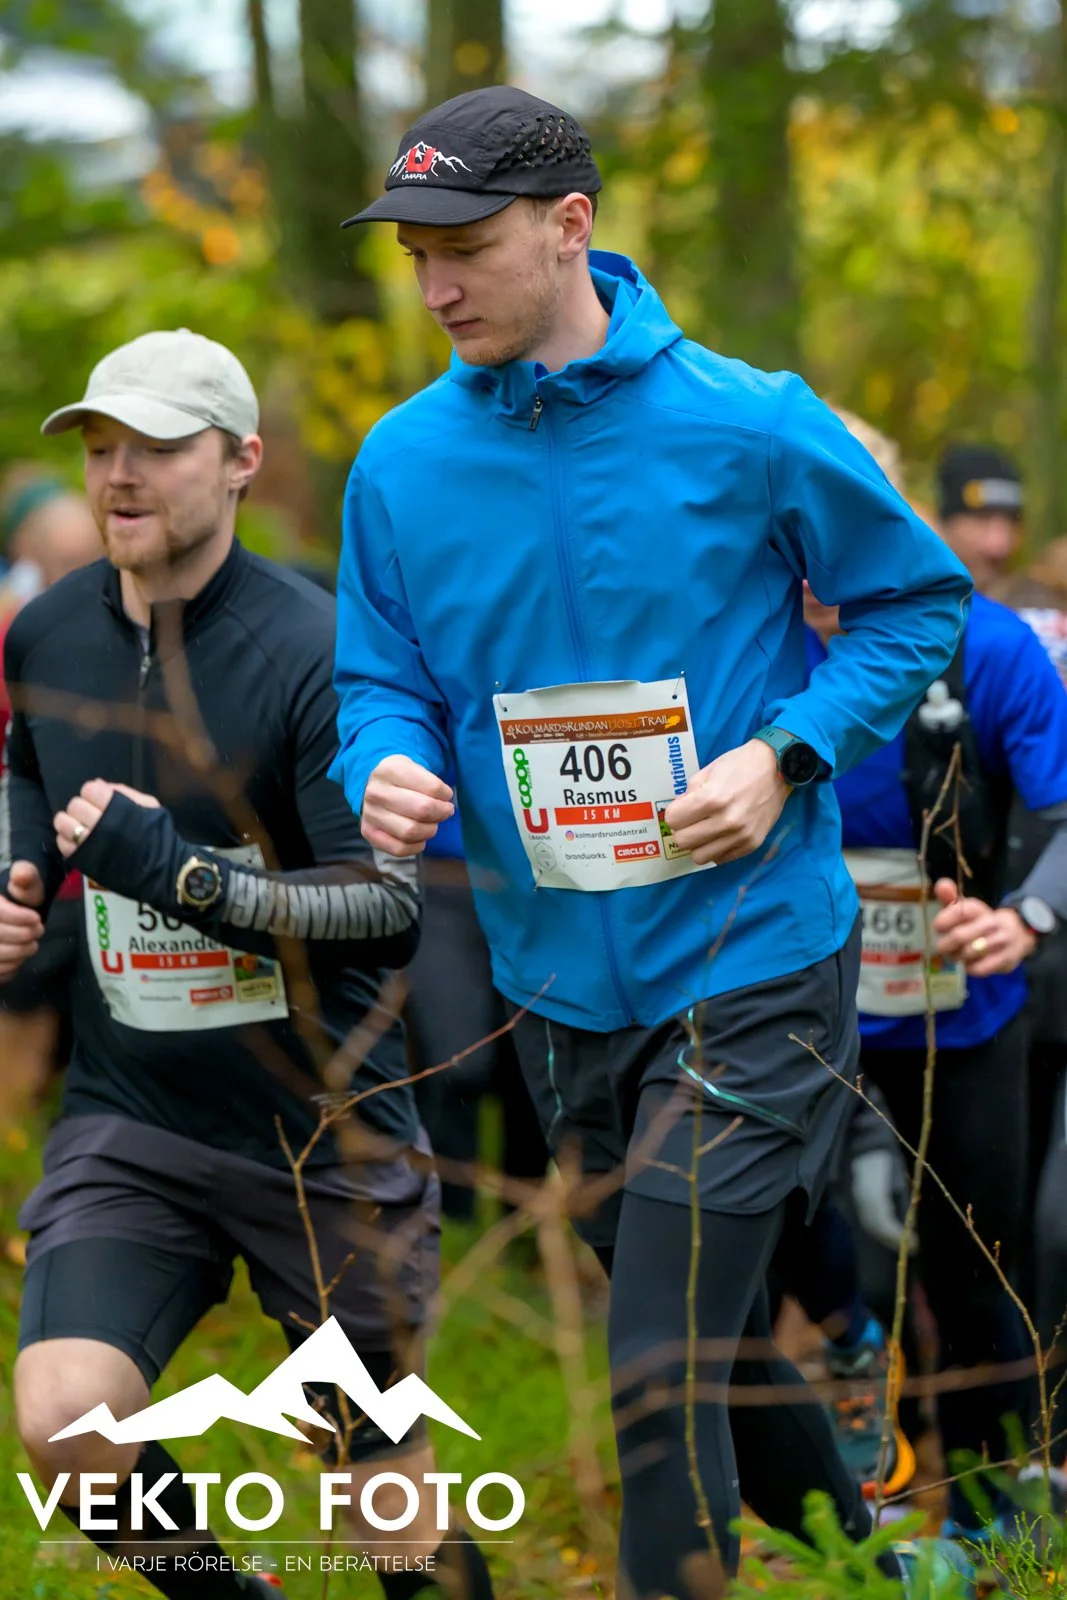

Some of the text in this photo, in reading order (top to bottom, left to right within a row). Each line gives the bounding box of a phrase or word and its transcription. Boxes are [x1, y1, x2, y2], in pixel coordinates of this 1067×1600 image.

[638, 715, 668, 727] TRAIL
[560, 743, 632, 782] 406
[668, 736, 687, 795] Aktivitus
[513, 748, 532, 808] coop
[563, 789, 637, 805] Rasmus
[583, 808, 620, 820] 15 KM
[617, 847, 644, 857] CIRCLE
[645, 844, 657, 855] K
[93, 894, 110, 950] coop
